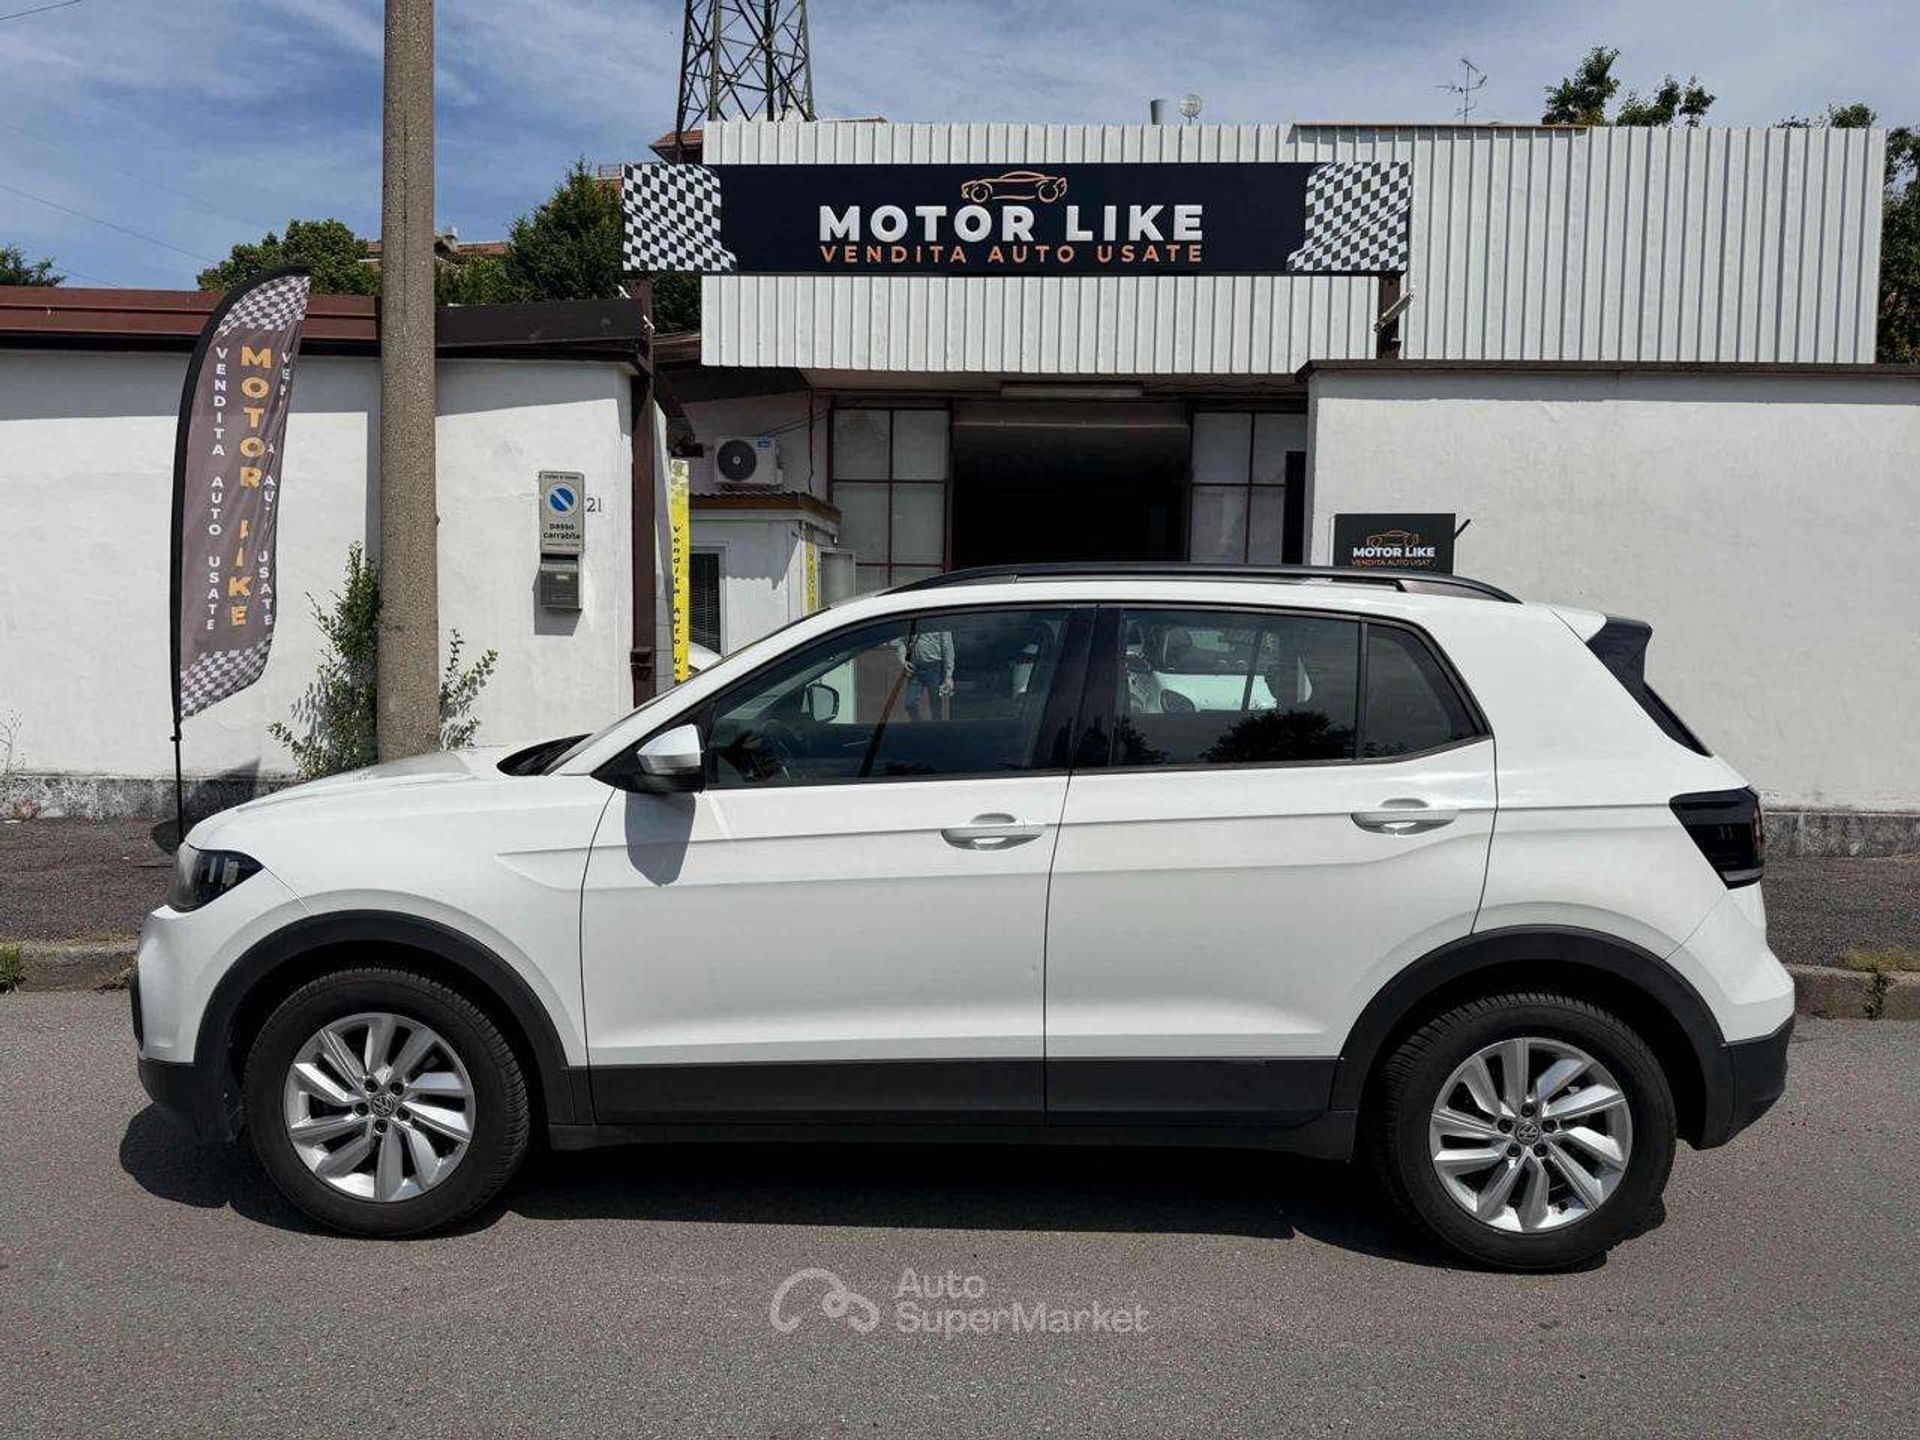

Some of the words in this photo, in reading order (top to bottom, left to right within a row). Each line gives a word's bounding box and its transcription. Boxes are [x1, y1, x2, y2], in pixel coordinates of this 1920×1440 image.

[819, 205, 1035, 242] MOTOR
[1066, 205, 1203, 242] LIKE
[820, 246, 967, 263] VENDITA
[987, 245, 1074, 263] AUTO
[1097, 245, 1202, 263] USATE
[211, 346, 229, 456] VENDITA
[239, 346, 272, 488] MOTOR
[208, 476, 224, 536] AUTO
[586, 497, 602, 513] 21
[1353, 547, 1402, 557] MOTOR
[1405, 547, 1436, 557] LIKE
[206, 556, 221, 630] USATE
[257, 551, 274, 626] USATE
